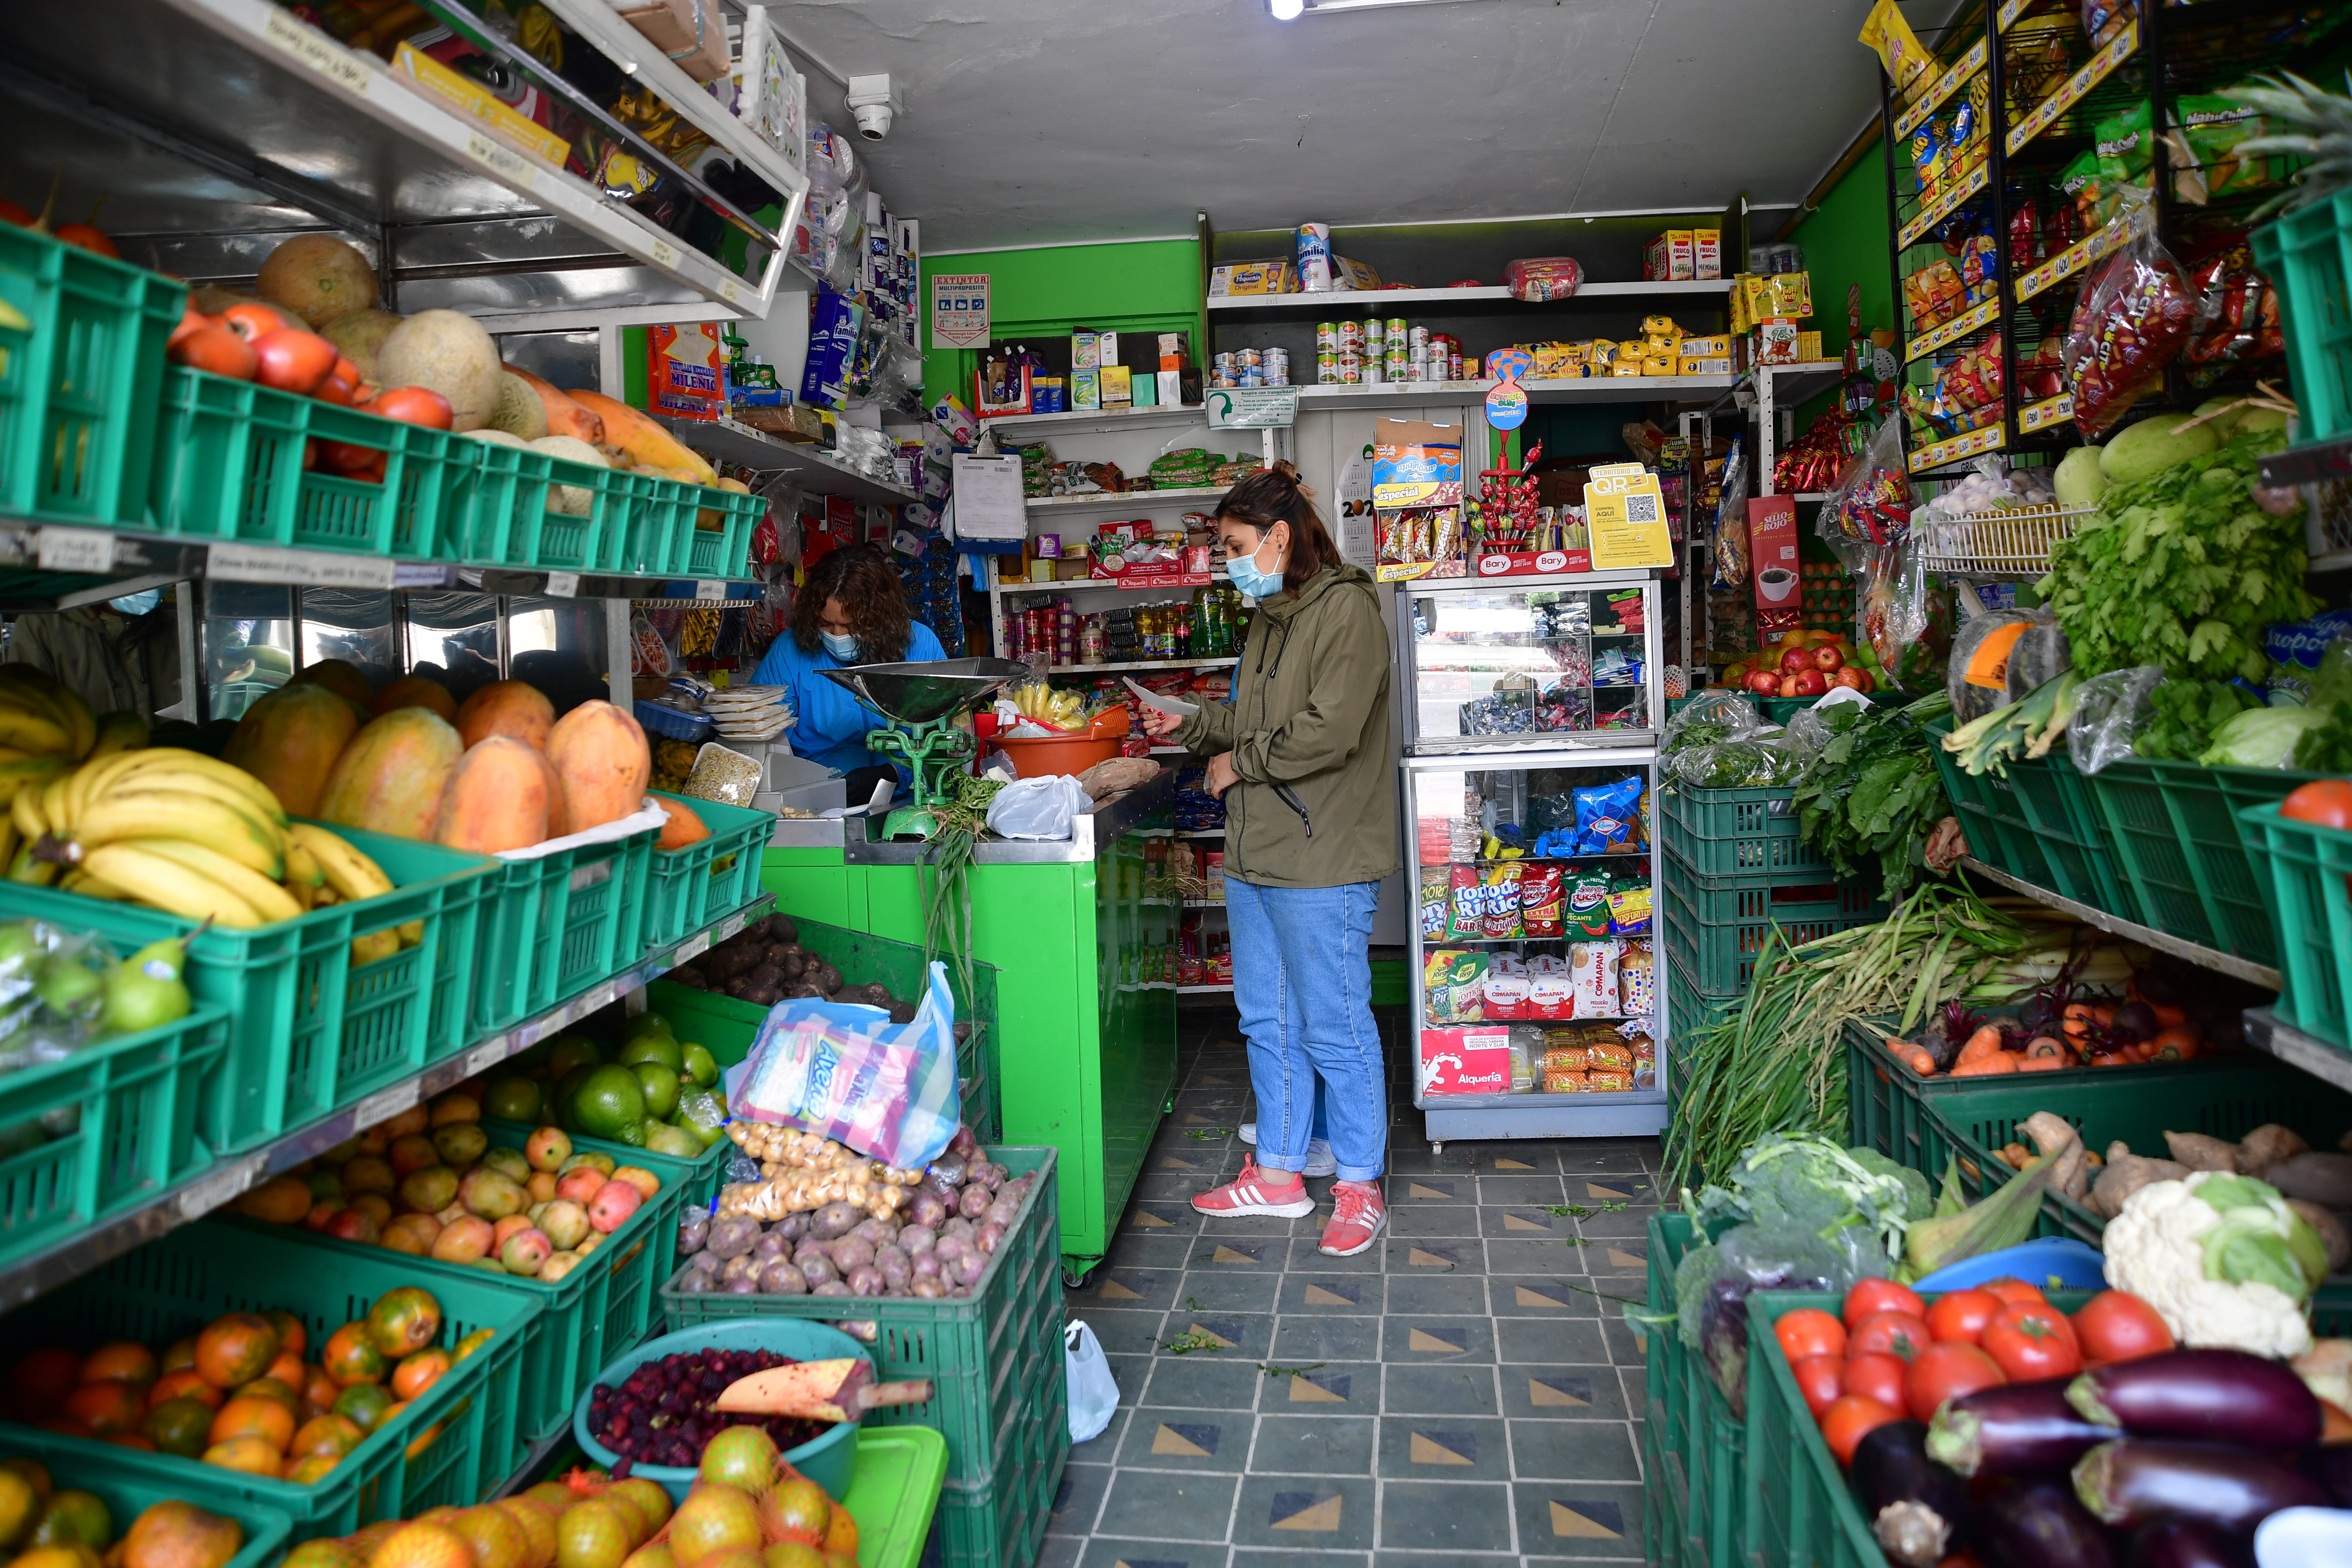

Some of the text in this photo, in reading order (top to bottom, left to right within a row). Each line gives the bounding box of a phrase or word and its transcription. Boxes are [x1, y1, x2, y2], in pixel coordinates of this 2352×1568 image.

[1235, 273, 1262, 283] Pequeñín
[834, 324, 857, 339] familia
[669, 360, 715, 377] TORTILLAS MEXICANAS
[671, 373, 716, 392] MILENIO
[1593, 477, 1629, 494] QR
[1378, 487, 1419, 501] especial
[1764, 512, 1787, 524] SELLO
[1764, 519, 1787, 531] ROJO
[1384, 565, 1421, 579] especial
[1486, 561, 1506, 569] Bary
[1573, 893, 1604, 902] RICAS
[1527, 905, 1556, 915] EXTRA
[1616, 909, 1652, 923] FOSFORITOS
[1454, 919, 1475, 931] BAR
[1492, 910, 1521, 934] original
[1459, 970, 1473, 978] Jorge
[1595, 952, 1604, 996] COMAPAN
[1457, 985, 1482, 1001] Tomat
[1463, 983, 1473, 992] Pasta
[808, 1040, 840, 1120] Avena
[1458, 1072, 1502, 1085] Alquería
